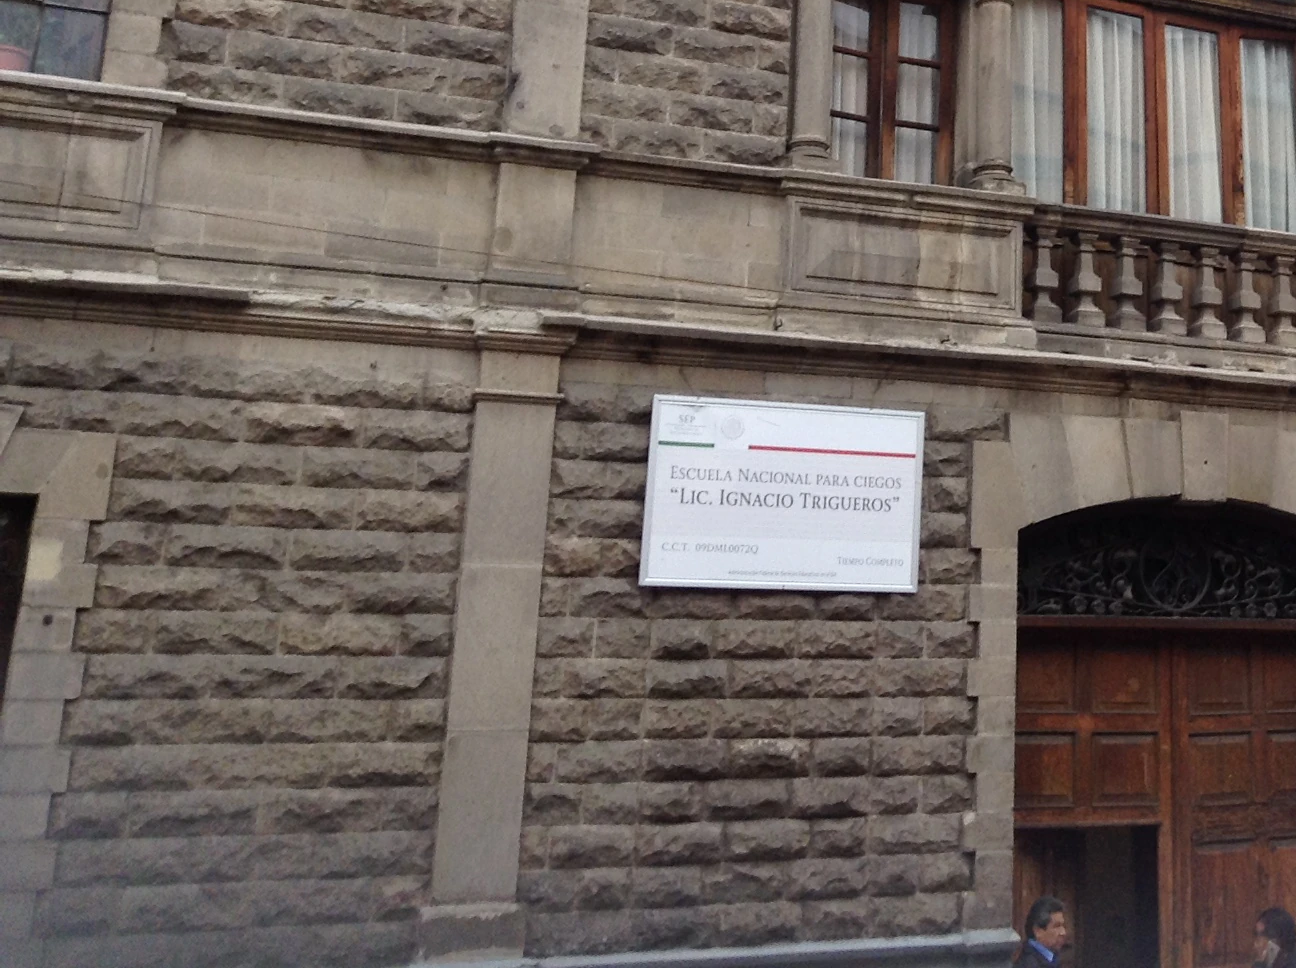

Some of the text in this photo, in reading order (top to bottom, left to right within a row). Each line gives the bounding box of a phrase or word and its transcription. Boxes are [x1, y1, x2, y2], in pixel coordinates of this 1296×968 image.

[670, 465, 902, 489] ESCUELA NACIONAL PARA CIEGOS
[719, 489, 794, 509] IGNACIO
